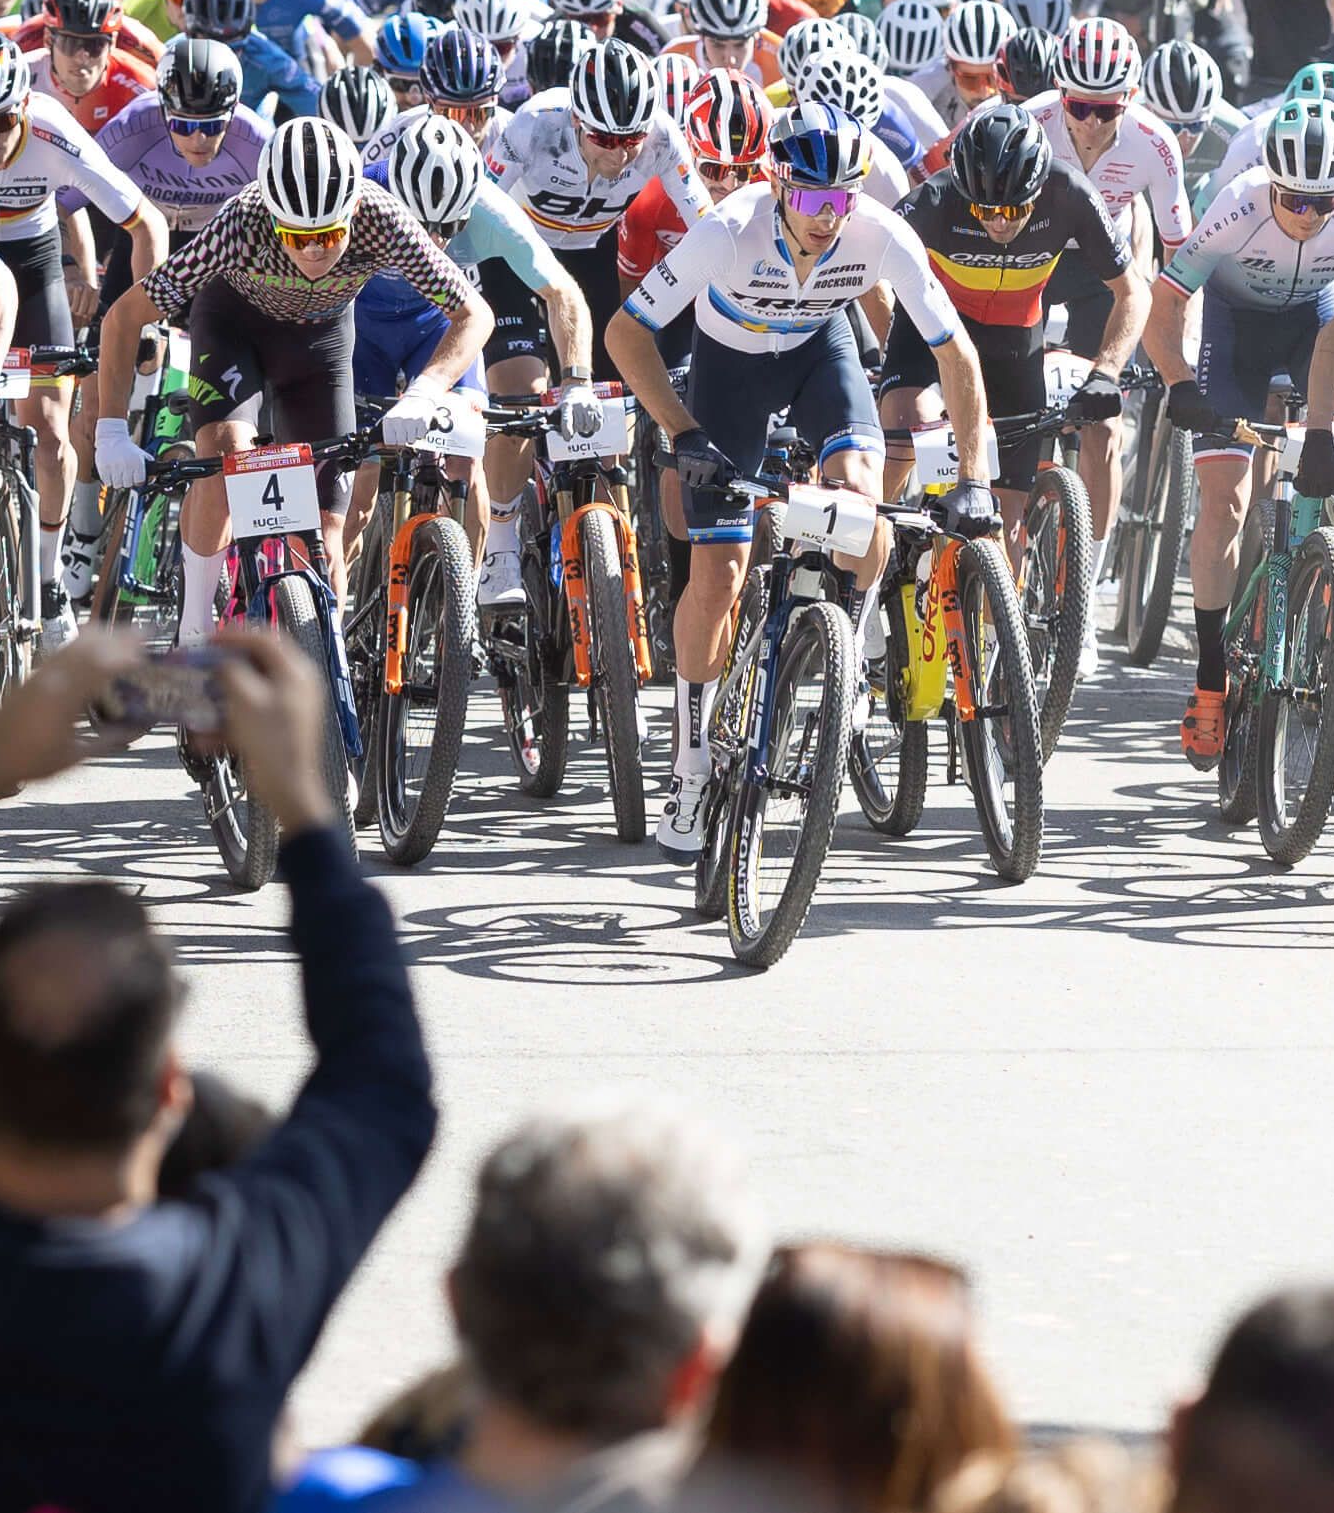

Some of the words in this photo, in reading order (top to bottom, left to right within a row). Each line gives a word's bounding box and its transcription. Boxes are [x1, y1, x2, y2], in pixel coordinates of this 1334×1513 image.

[1050, 367, 1086, 391] 15
[262, 473, 285, 511] 4
[822, 502, 838, 535] 1
[690, 695, 700, 745] TREK
